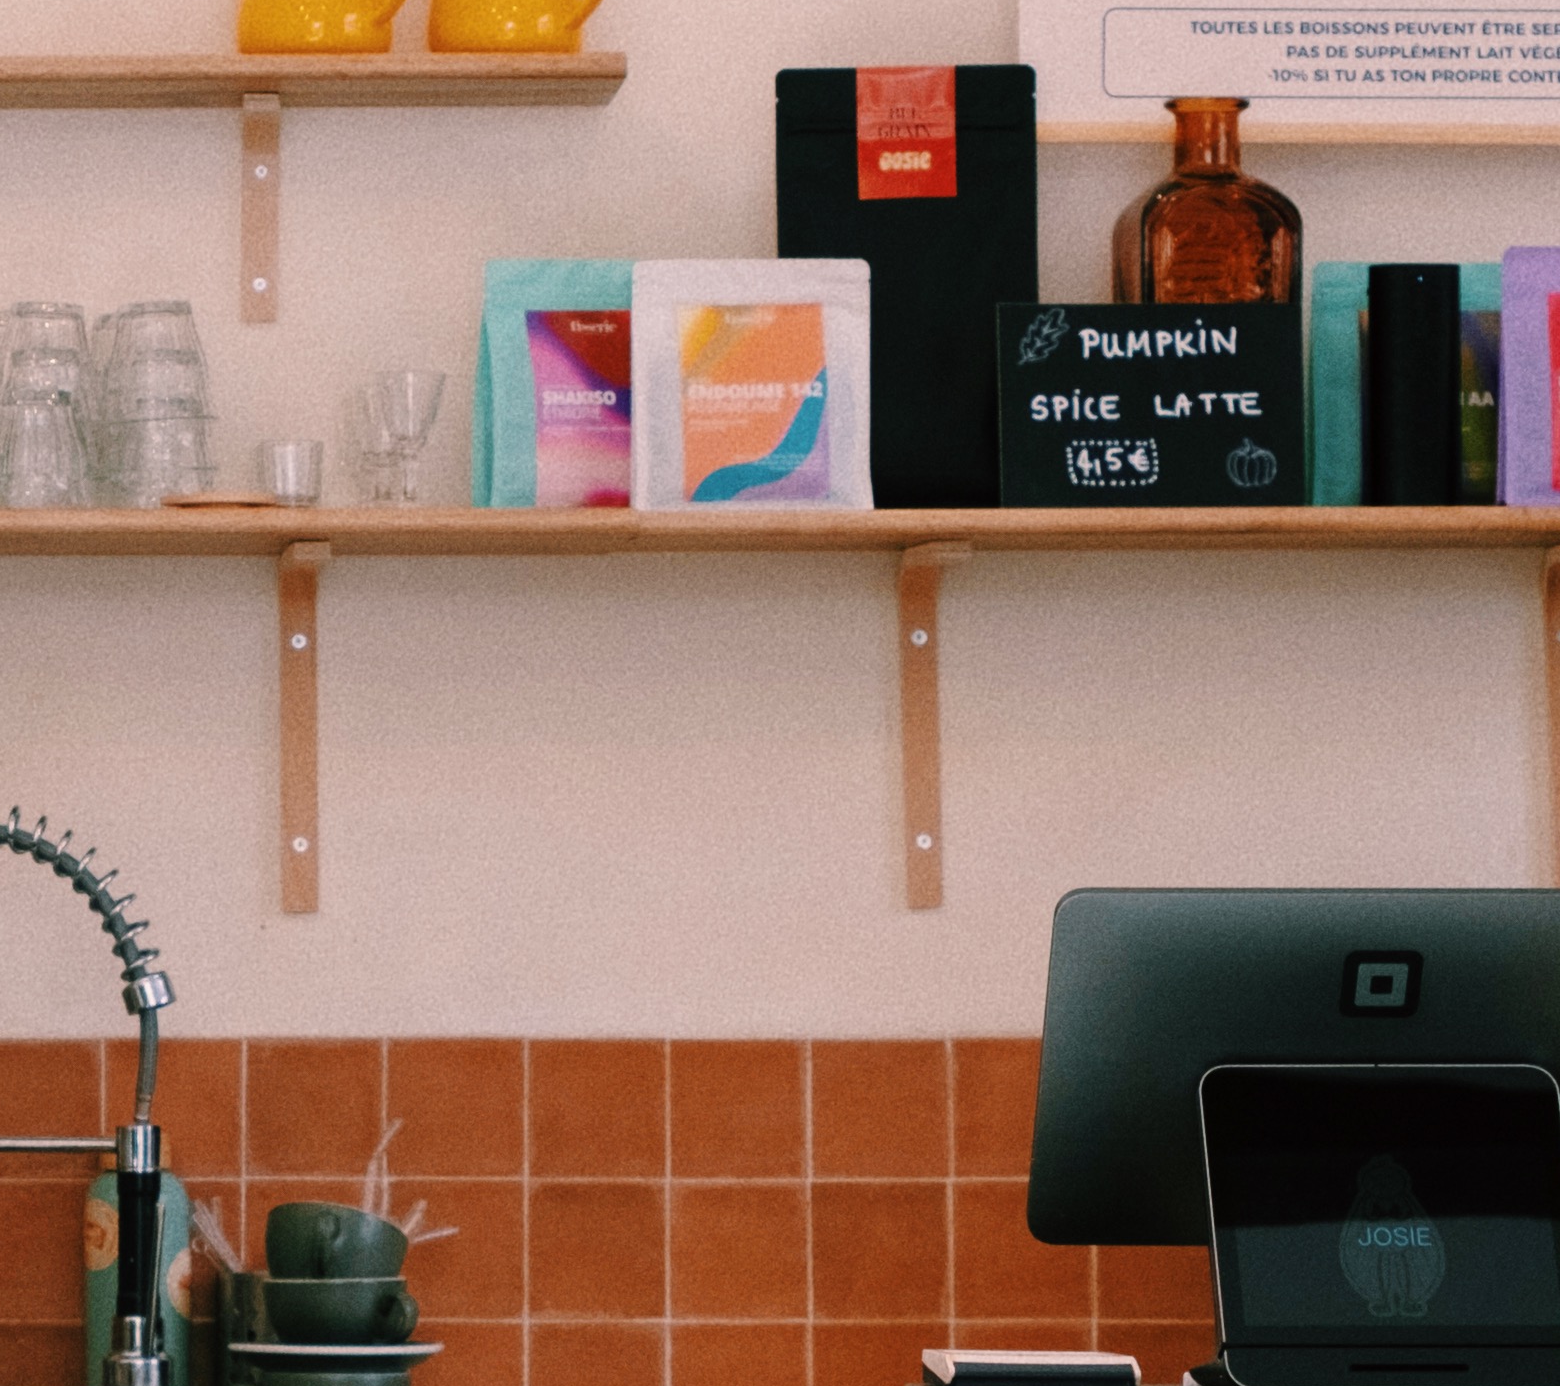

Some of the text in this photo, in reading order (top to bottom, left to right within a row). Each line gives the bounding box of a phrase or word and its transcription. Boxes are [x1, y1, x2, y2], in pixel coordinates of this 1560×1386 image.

[1191, 20, 1258, 35] TOUTES
[1263, 21, 1294, 36] LES
[1299, 21, 1390, 35] BOISSONS
[1394, 22, 1475, 35] PEUVENT
[1481, 21, 1525, 36] ÊTRE
[1286, 45, 1320, 59] PAS
[1324, 45, 1348, 59] DE
[1354, 45, 1470, 59] SUPPLÉMENT
[1476, 46, 1514, 60] LAIT
[1313, 68, 1330, 83] SI
[1335, 68, 1357, 83] TU
[1362, 69, 1385, 83] AS
[1390, 69, 1427, 83] TON
[1431, 69, 1502, 83] PROPRE
[541, 389, 617, 406] SHAKISO
[1153, 391, 1263, 418] LATTE
[1358, 1226, 1433, 1249] JOSIE
